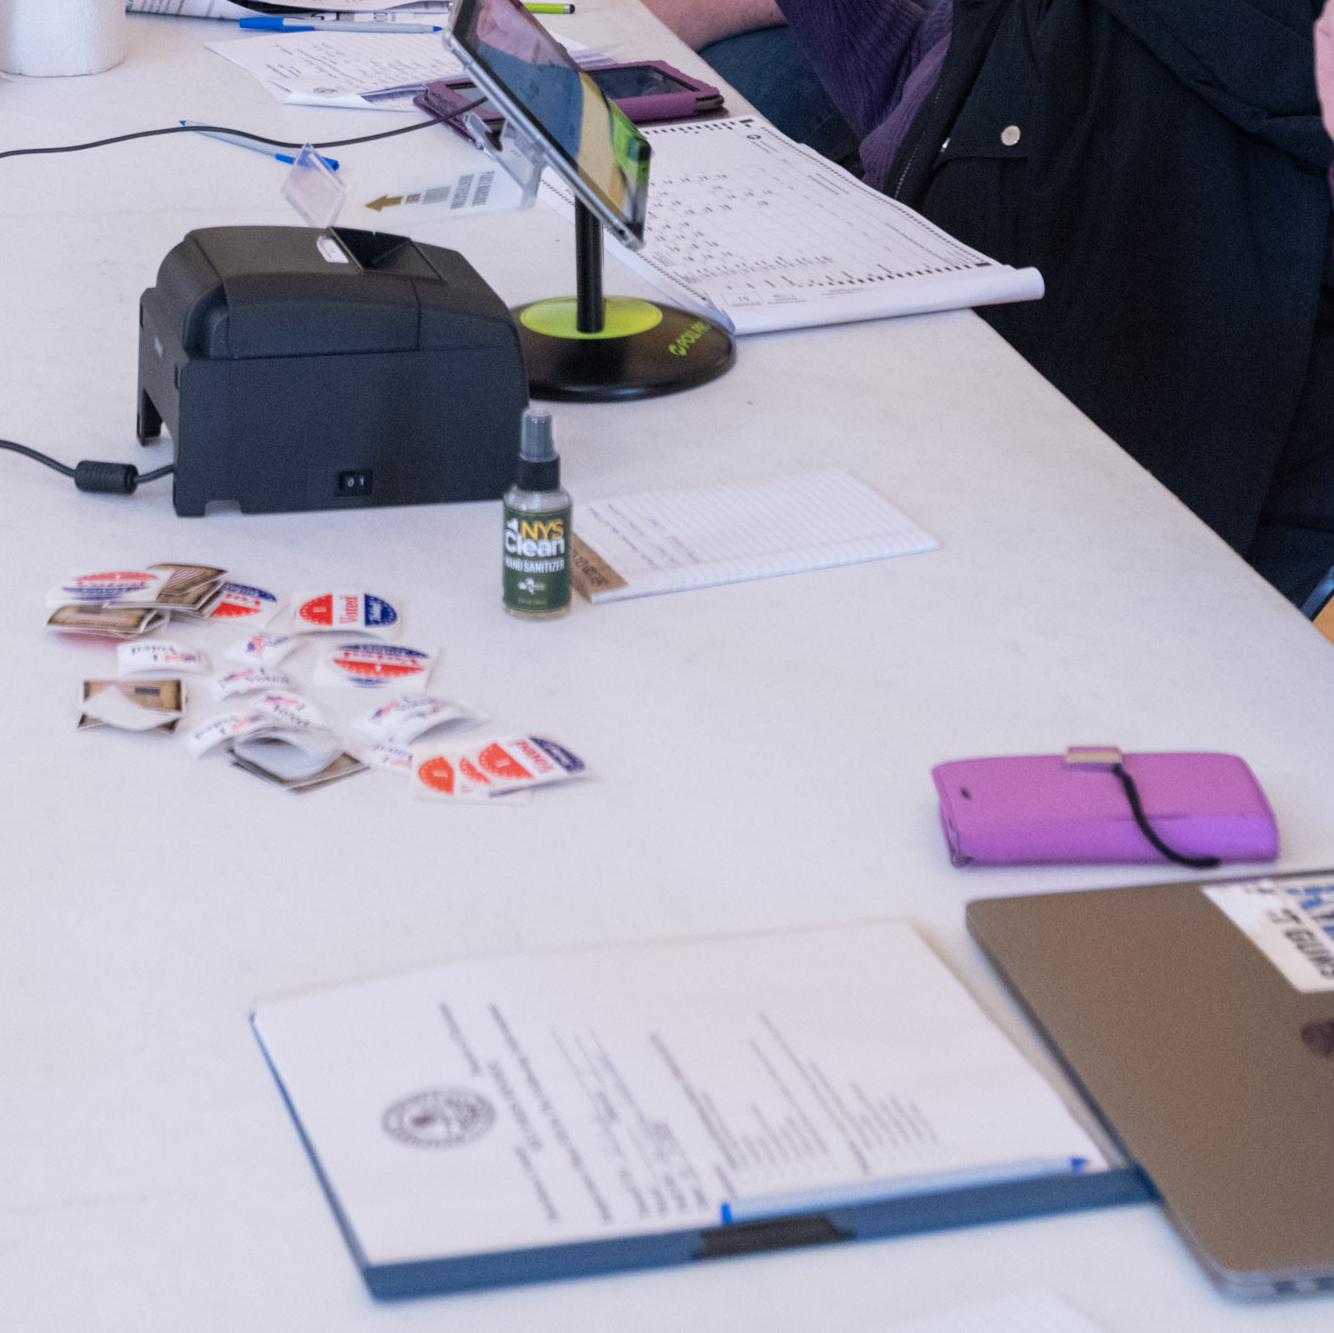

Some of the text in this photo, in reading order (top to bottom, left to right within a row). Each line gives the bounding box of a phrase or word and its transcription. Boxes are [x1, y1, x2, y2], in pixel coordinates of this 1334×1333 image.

[521, 519, 564, 540] NYS
[505, 528, 565, 558] Clean
[505, 557, 565, 574] HAND SANITIZER
[339, 594, 359, 625] Voted
